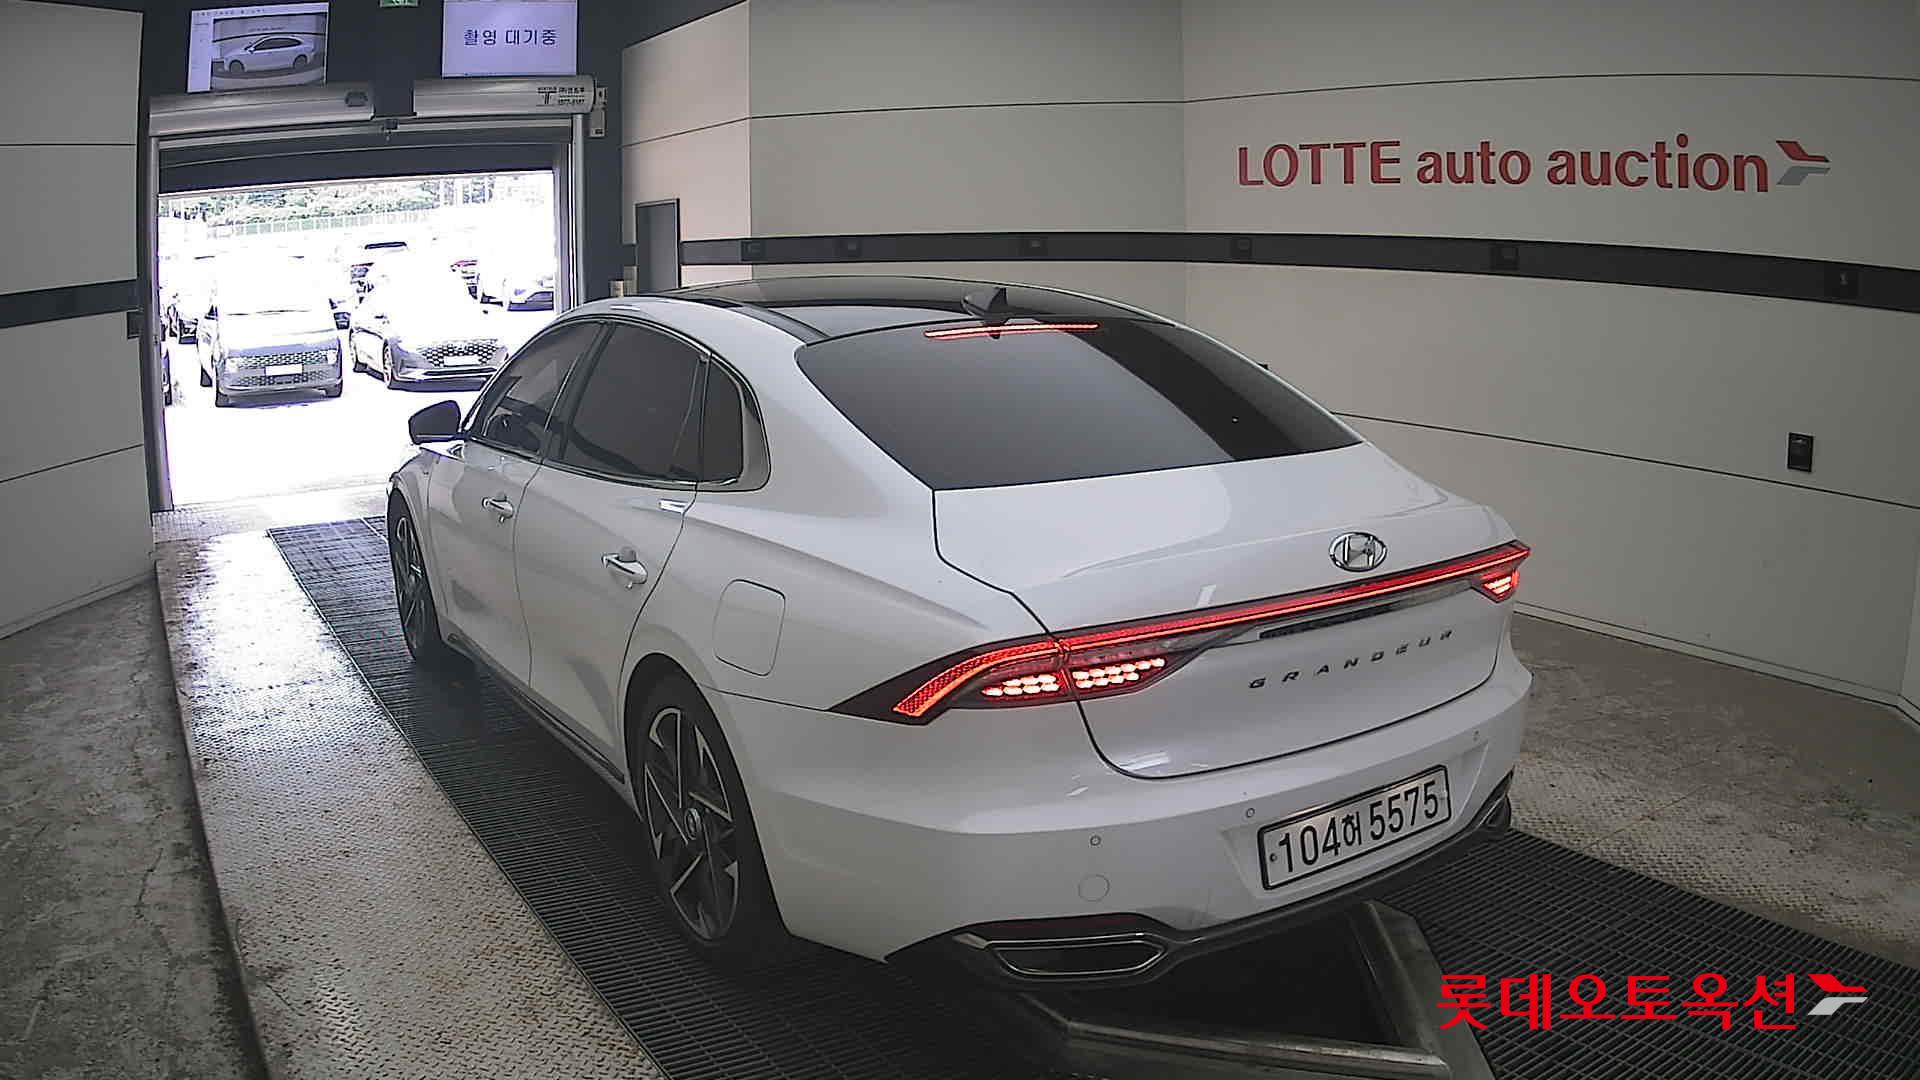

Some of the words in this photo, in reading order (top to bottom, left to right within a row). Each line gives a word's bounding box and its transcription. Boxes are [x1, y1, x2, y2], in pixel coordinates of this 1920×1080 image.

[464, 29, 497, 46] 촬영
[505, 29, 557, 46] 대기중
[1238, 141, 1401, 187] LOTTE
[1416, 141, 1531, 186] auto
[1547, 133, 1769, 193] auction
[1249, 630, 1453, 689] GRANDEUR
[1369, 780, 1439, 840] 5575
